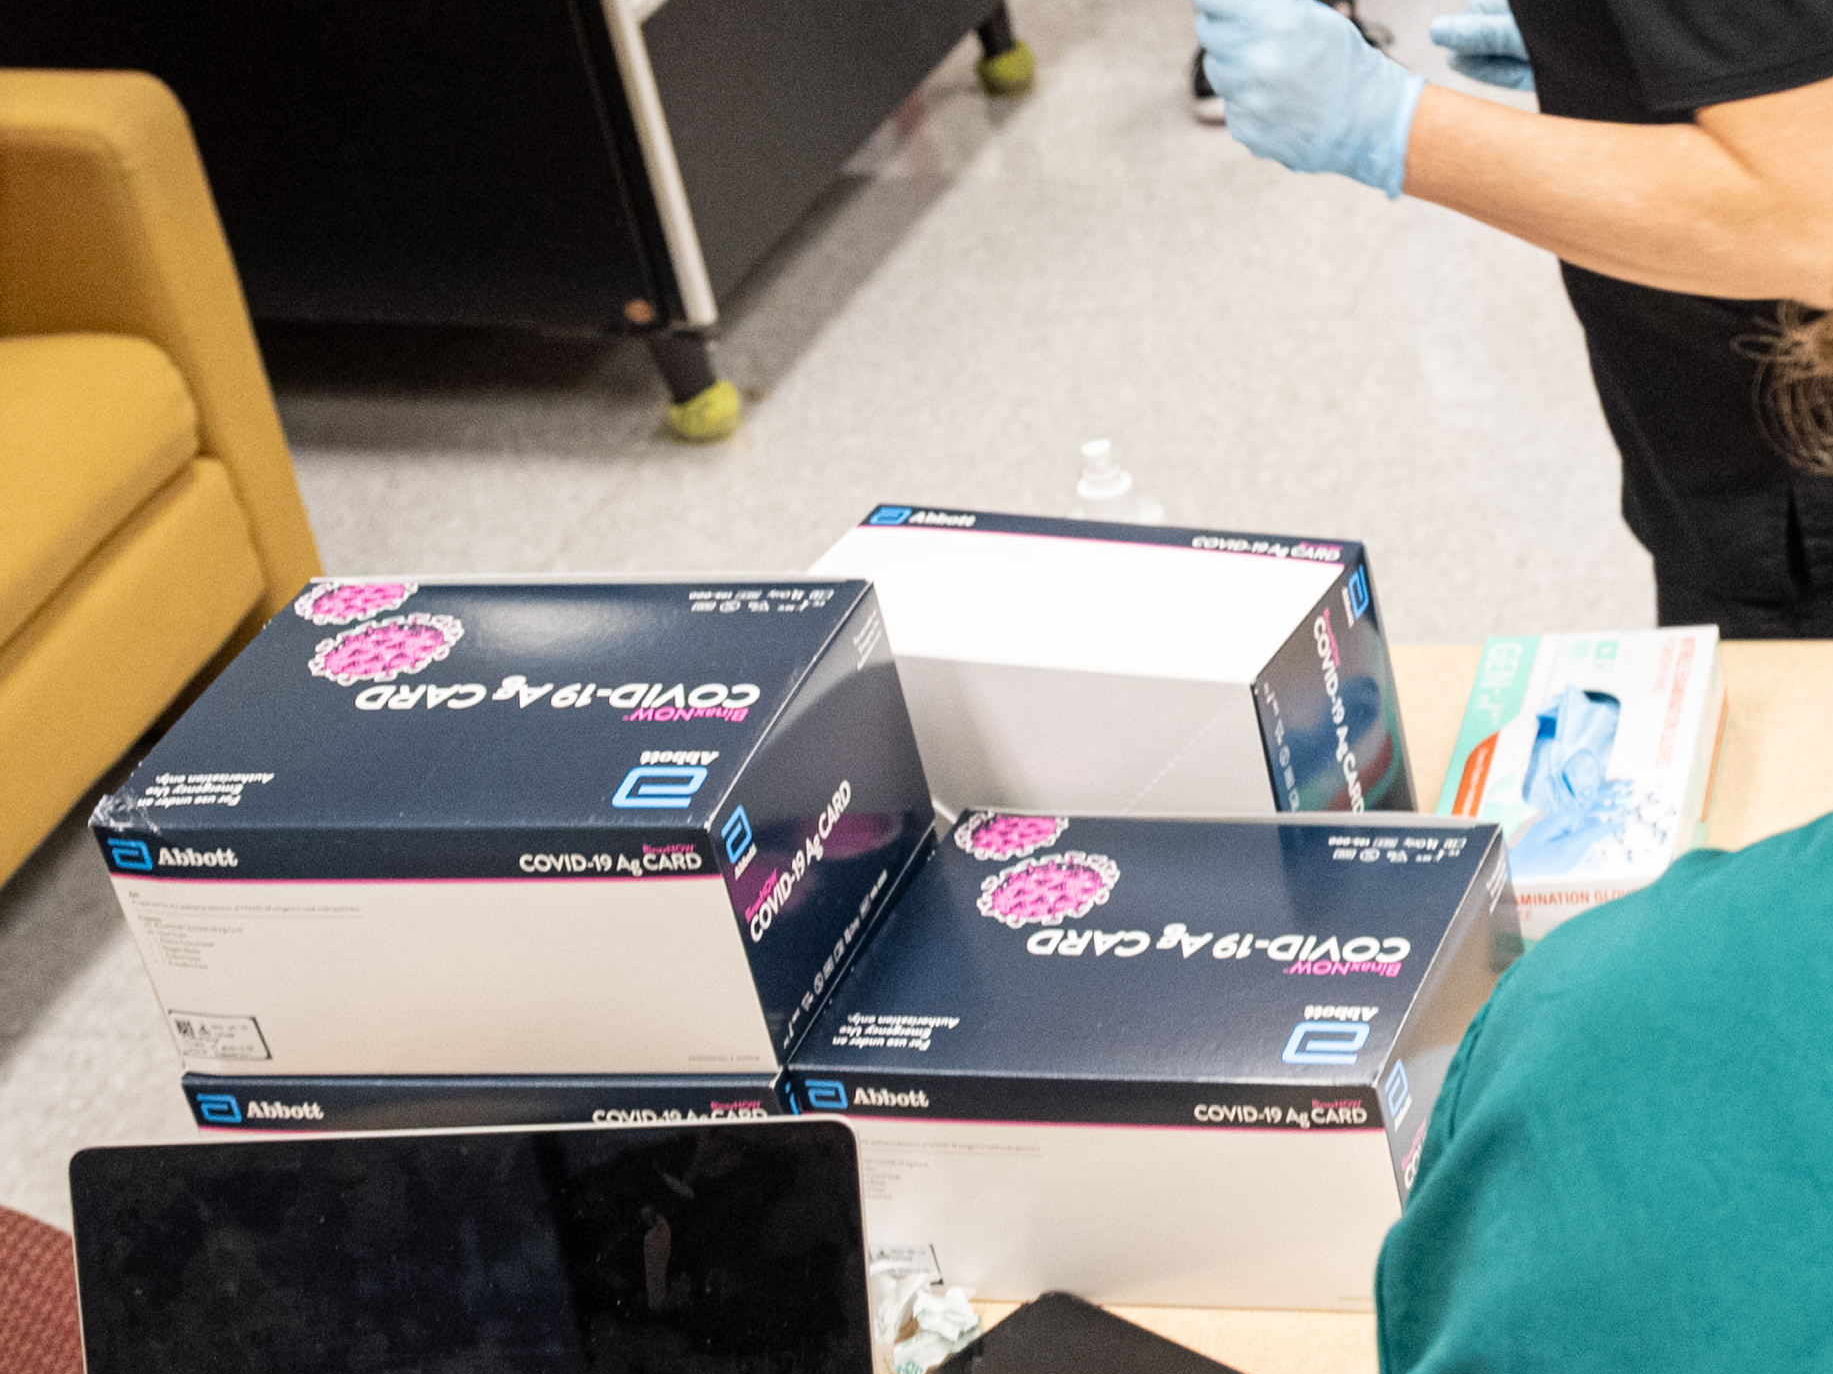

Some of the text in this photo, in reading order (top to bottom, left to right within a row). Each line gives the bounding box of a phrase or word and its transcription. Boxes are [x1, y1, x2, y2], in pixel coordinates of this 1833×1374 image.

[908, 511, 976, 527] Abbott
[1191, 536, 1267, 555] COVID-19
[1290, 545, 1340, 562] CARD
[354, 674, 761, 710] COVID-19 Ag CARD
[1313, 615, 1346, 725] COVID-19
[1343, 752, 1365, 815] CARD
[640, 751, 720, 765] Abbott
[158, 847, 238, 867] Abbott
[519, 853, 702, 877] COVID-19 Ag CARD
[749, 779, 852, 944] COVID-19 Ag CARD
[1515, 891, 1590, 906] AMINATION
[1026, 923, 1411, 963] COVID-19 Ag CARD
[1303, 1005, 1379, 1022] Abbott
[854, 1087, 929, 1107] Abbott
[248, 1101, 324, 1119] Abbott
[1194, 1104, 1368, 1129] COVID-19 Ag CARD
